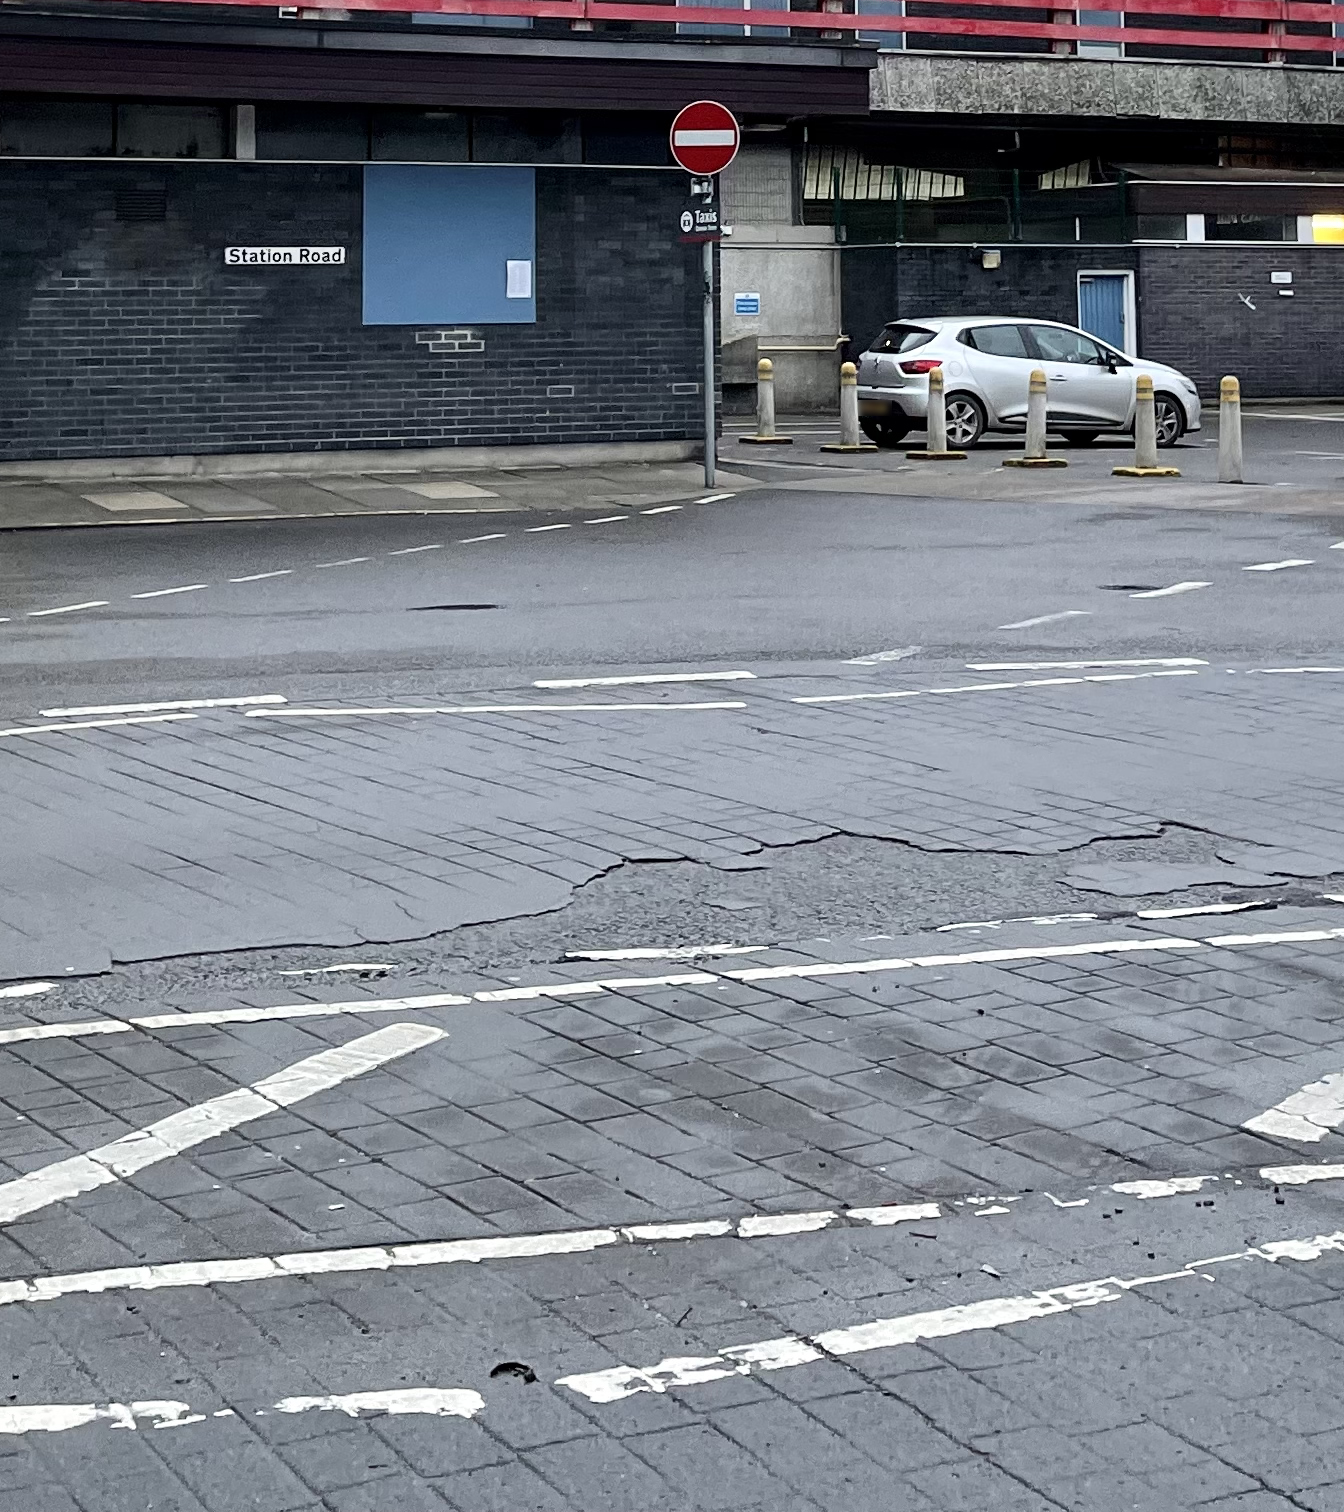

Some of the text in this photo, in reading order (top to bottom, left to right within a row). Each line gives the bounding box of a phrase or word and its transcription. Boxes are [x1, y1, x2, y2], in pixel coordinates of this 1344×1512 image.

[695, 208, 717, 223] Taxis
[229, 248, 341, 263] Station Road
